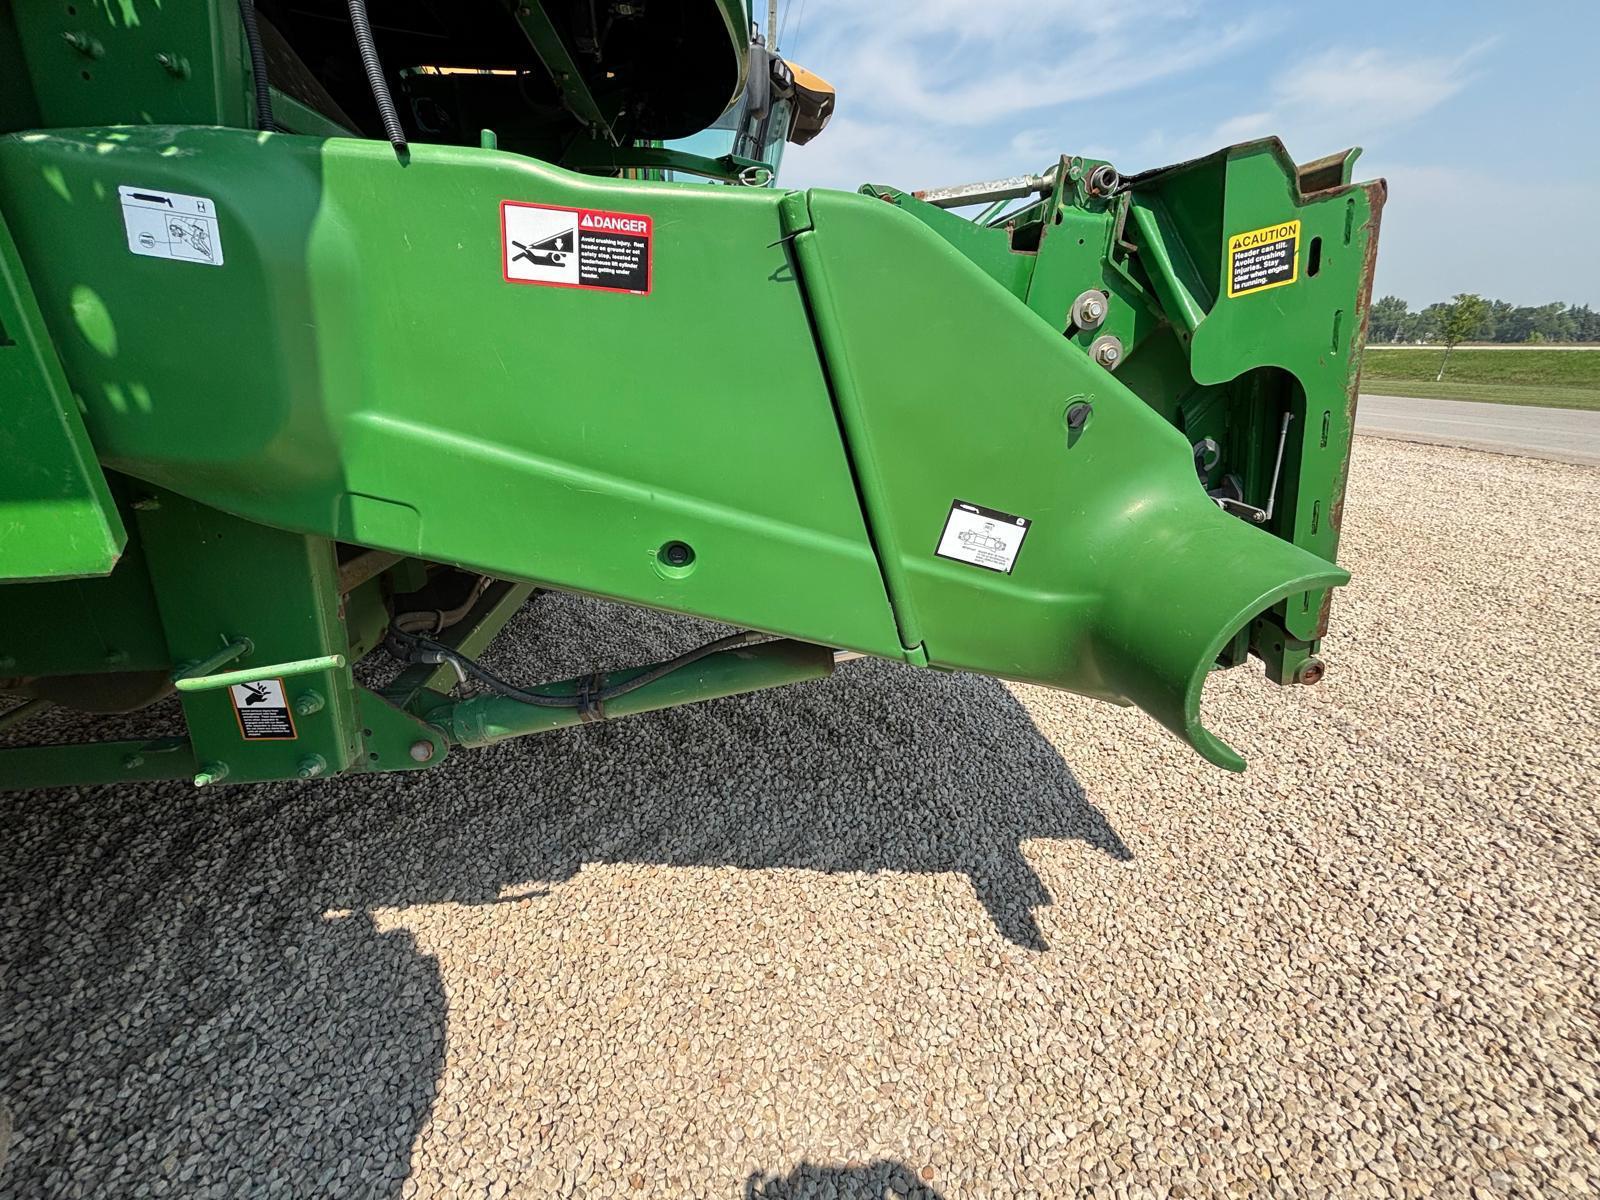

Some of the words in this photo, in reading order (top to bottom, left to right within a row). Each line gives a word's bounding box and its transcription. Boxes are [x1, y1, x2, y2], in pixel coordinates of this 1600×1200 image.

[594, 215, 647, 233] DANGER
[596, 238, 616, 246] crushing
[1242, 224, 1296, 247] CAUTION
[1235, 249, 1260, 260] Header
[1261, 246, 1274, 254] can
[1235, 257, 1255, 267] Avoid
[1255, 250, 1286, 262] crushing
[1234, 274, 1249, 282] clear
[1250, 270, 1267, 278] when
[1268, 264, 1289, 274] engine
[1235, 264, 1262, 275] injuries.
[1263, 259, 1279, 268] Stay
[1234, 282, 1240, 290] is
[1241, 277, 1267, 288] running.
